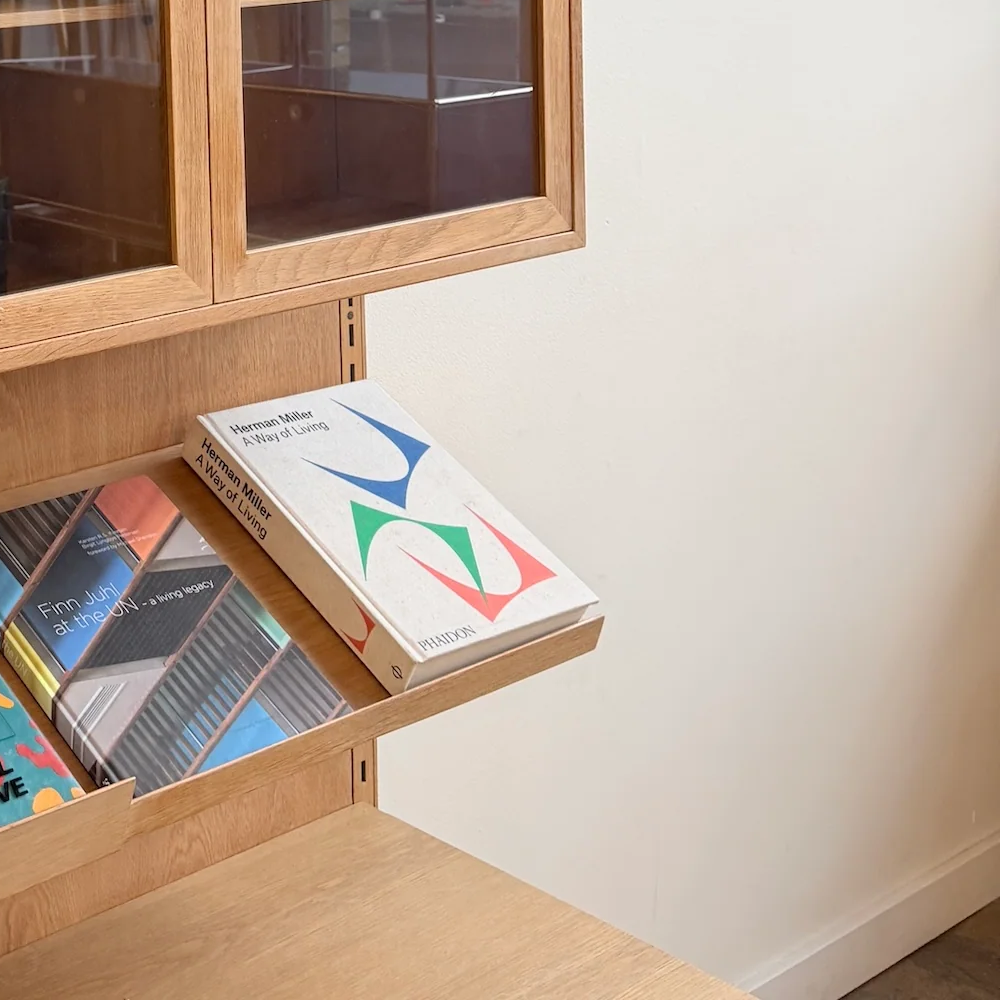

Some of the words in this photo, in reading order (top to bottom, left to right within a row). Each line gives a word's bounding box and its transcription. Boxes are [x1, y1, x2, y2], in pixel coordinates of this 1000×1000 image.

[229, 417, 281, 435] Herman
[278, 410, 314, 424] Miller
[242, 436, 254, 447] A
[250, 432, 280, 445] Way
[280, 427, 293, 438] of
[291, 421, 330, 435] Living
[201, 437, 241, 488] Herman
[241, 482, 272, 521] Miller
[195, 454, 203, 468] A
[205, 462, 226, 492] Way
[226, 489, 238, 504] of
[237, 500, 268, 541] Living
[37, 597, 82, 619] Finn
[85, 582, 121, 606] Juhl
[52, 619, 74, 636] at
[74, 611, 107, 629] the
[105, 597, 140, 618] UN
[148, 598, 157, 606] a
[155, 588, 184, 605] living
[182, 579, 215, 595] legacy
[417, 624, 477, 652] PHAIDON
[14, 656, 29, 677] UN
